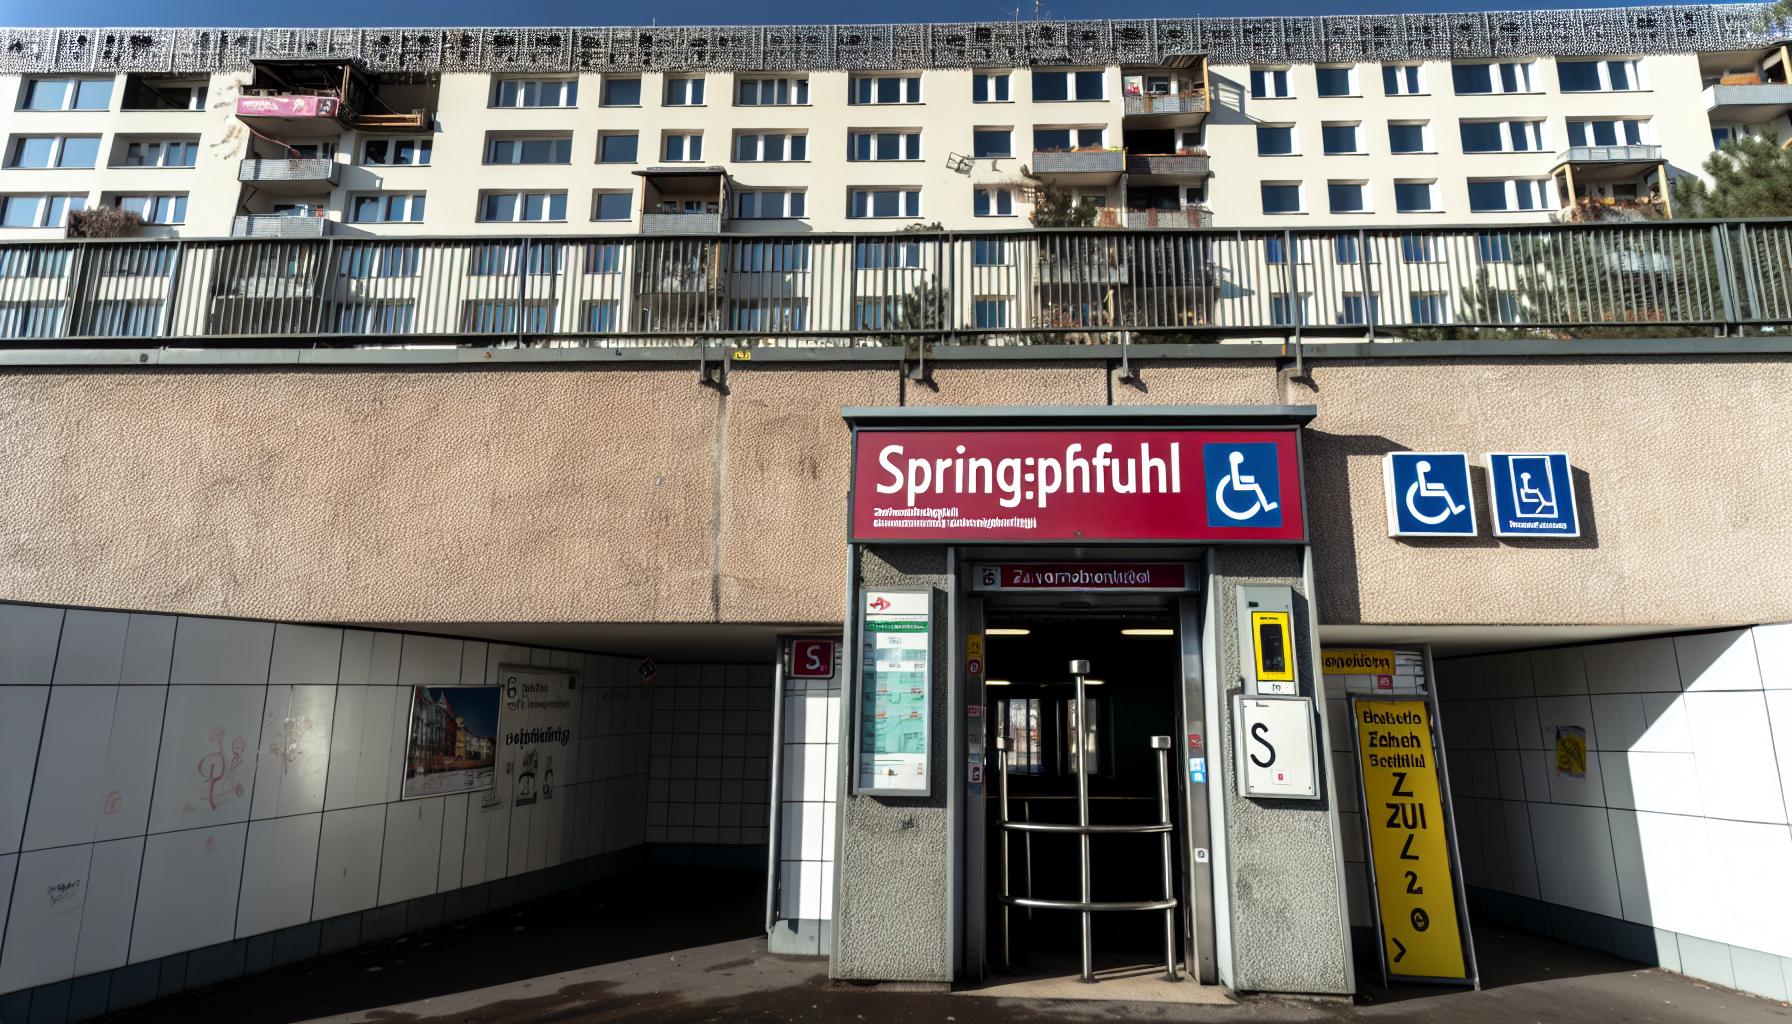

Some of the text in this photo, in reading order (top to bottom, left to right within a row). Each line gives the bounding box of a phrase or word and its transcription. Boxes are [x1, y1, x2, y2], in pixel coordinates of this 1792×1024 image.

[805, 644, 821, 670] S
[1250, 722, 1276, 768] S
[1391, 772, 1414, 798] Z
